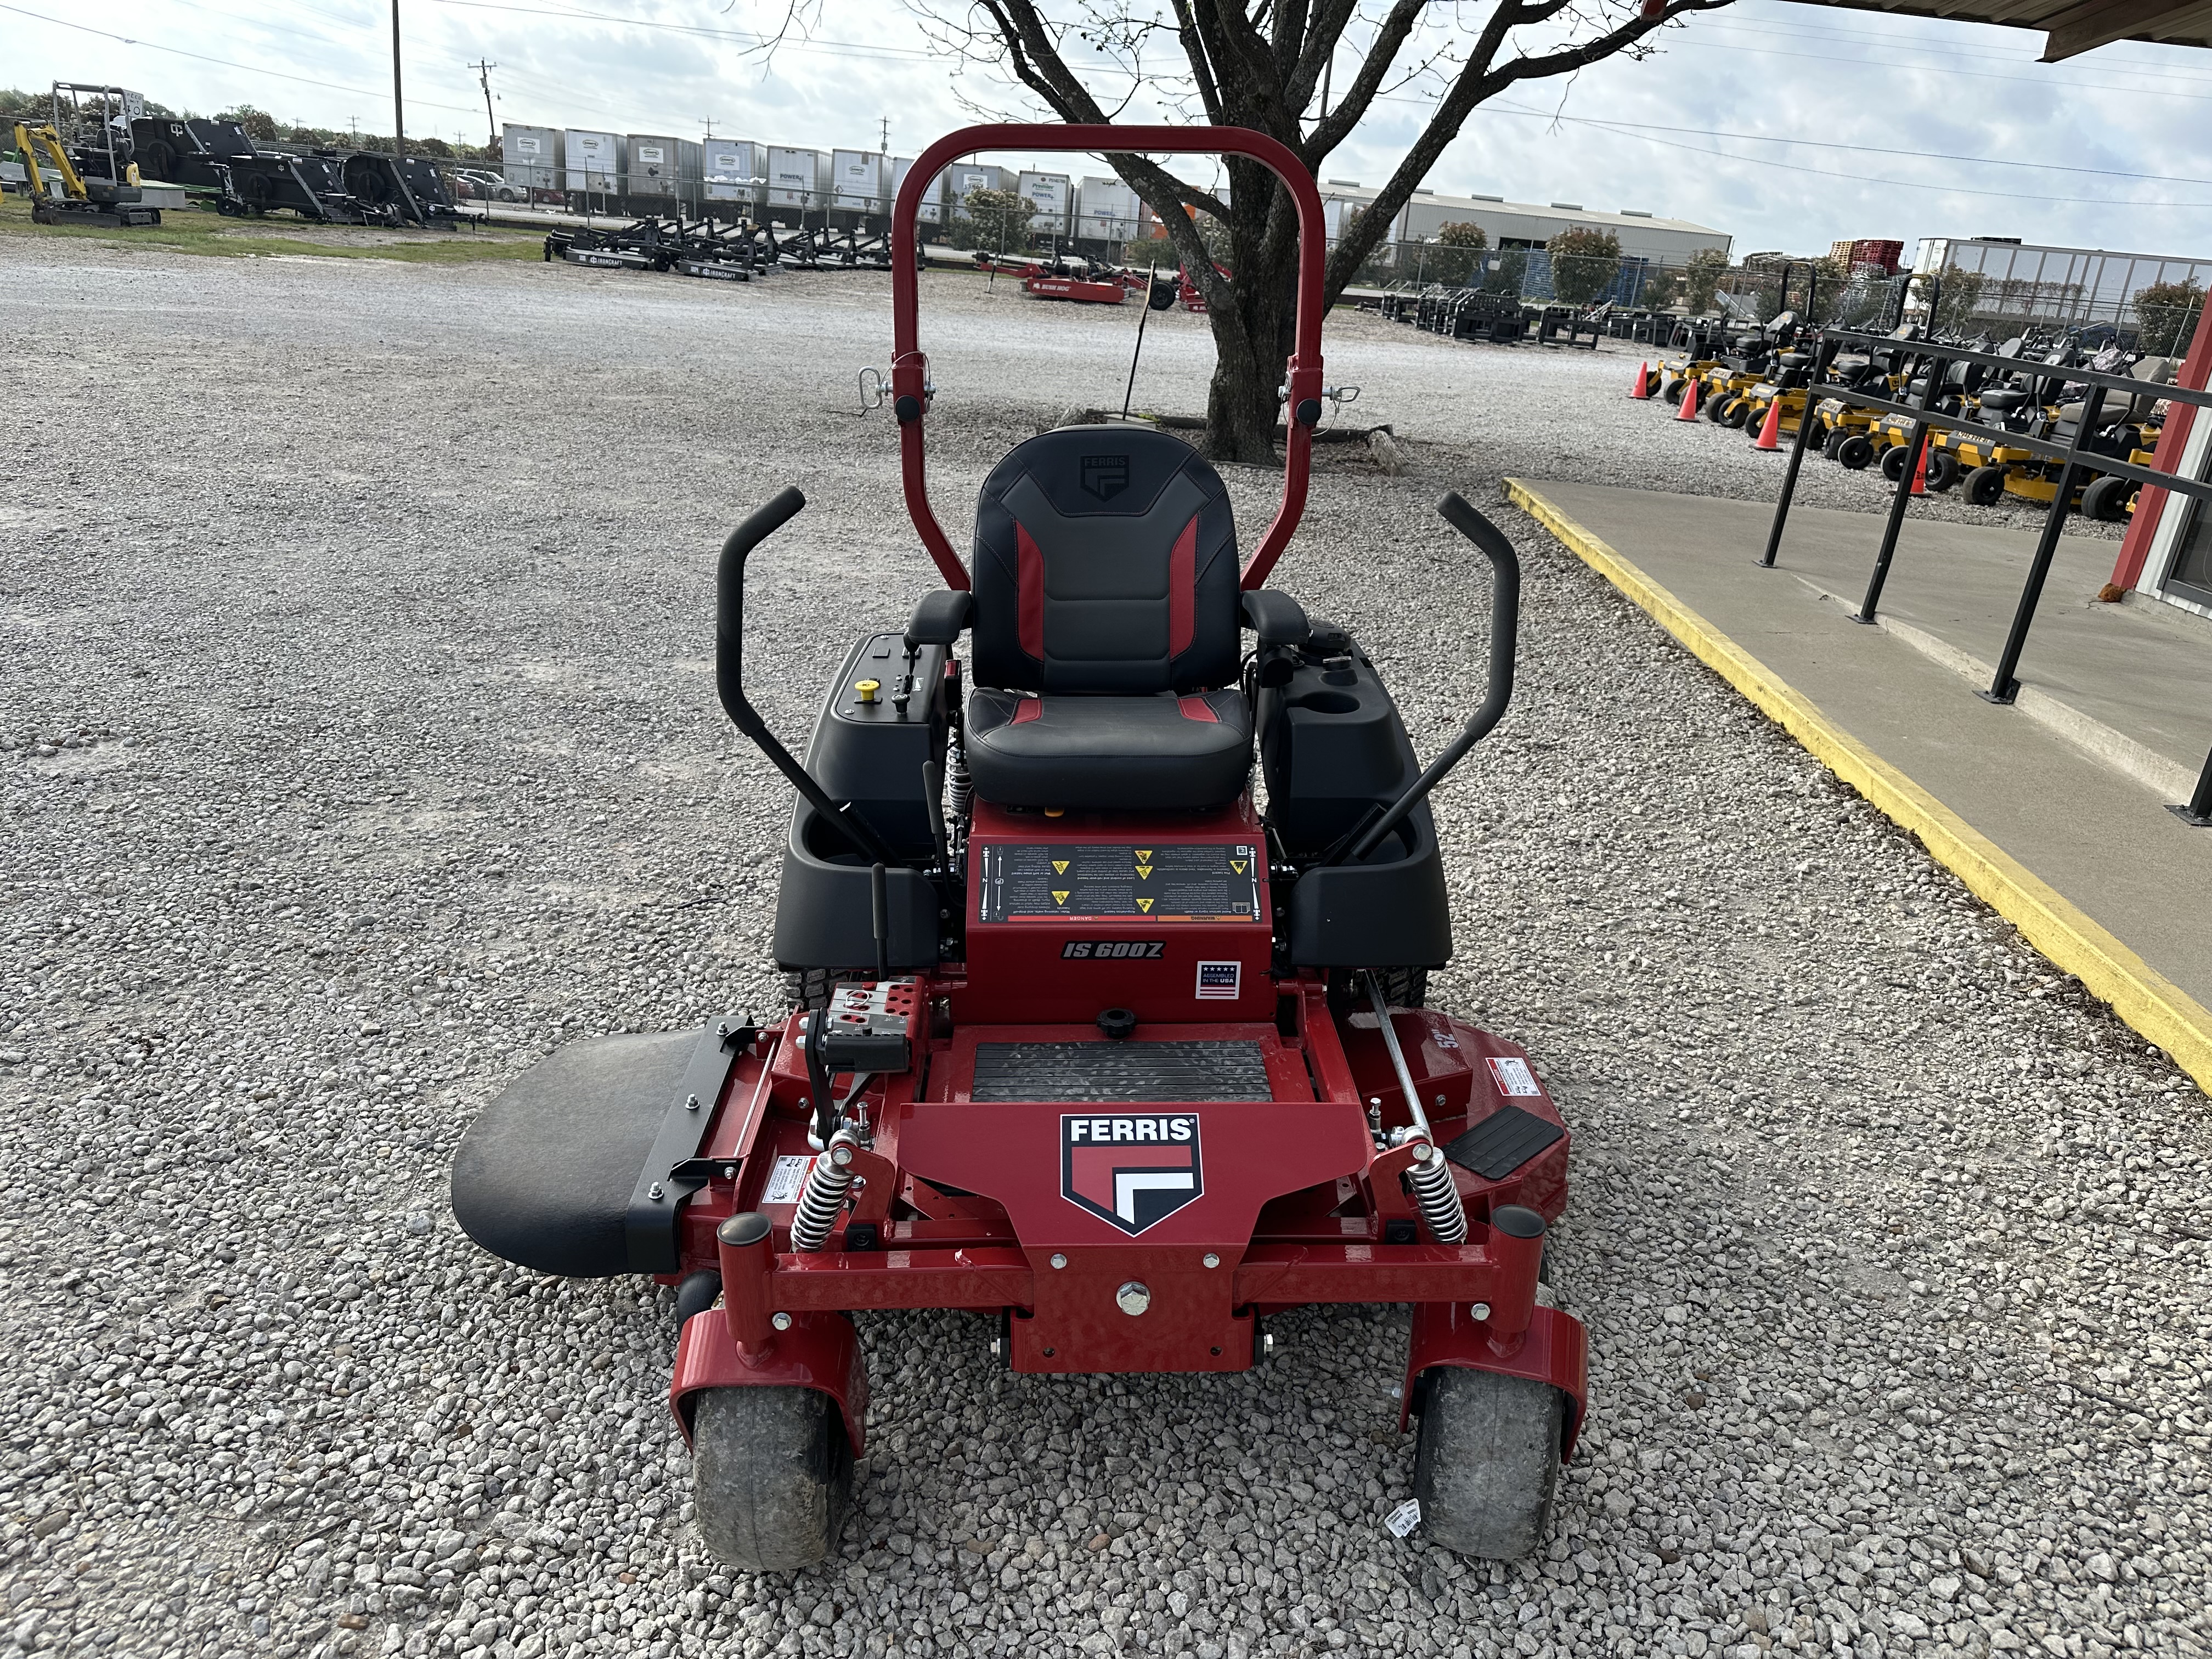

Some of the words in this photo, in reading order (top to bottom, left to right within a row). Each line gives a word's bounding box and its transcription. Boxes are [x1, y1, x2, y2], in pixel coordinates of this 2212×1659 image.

[710, 270, 735, 279] IRONCRAFT
[1084, 457, 1125, 466] FERRIS
[1063, 943, 1092, 957] IS
[1094, 943, 1164, 957] 600Z
[1071, 1118, 1192, 1141] FERRIS
